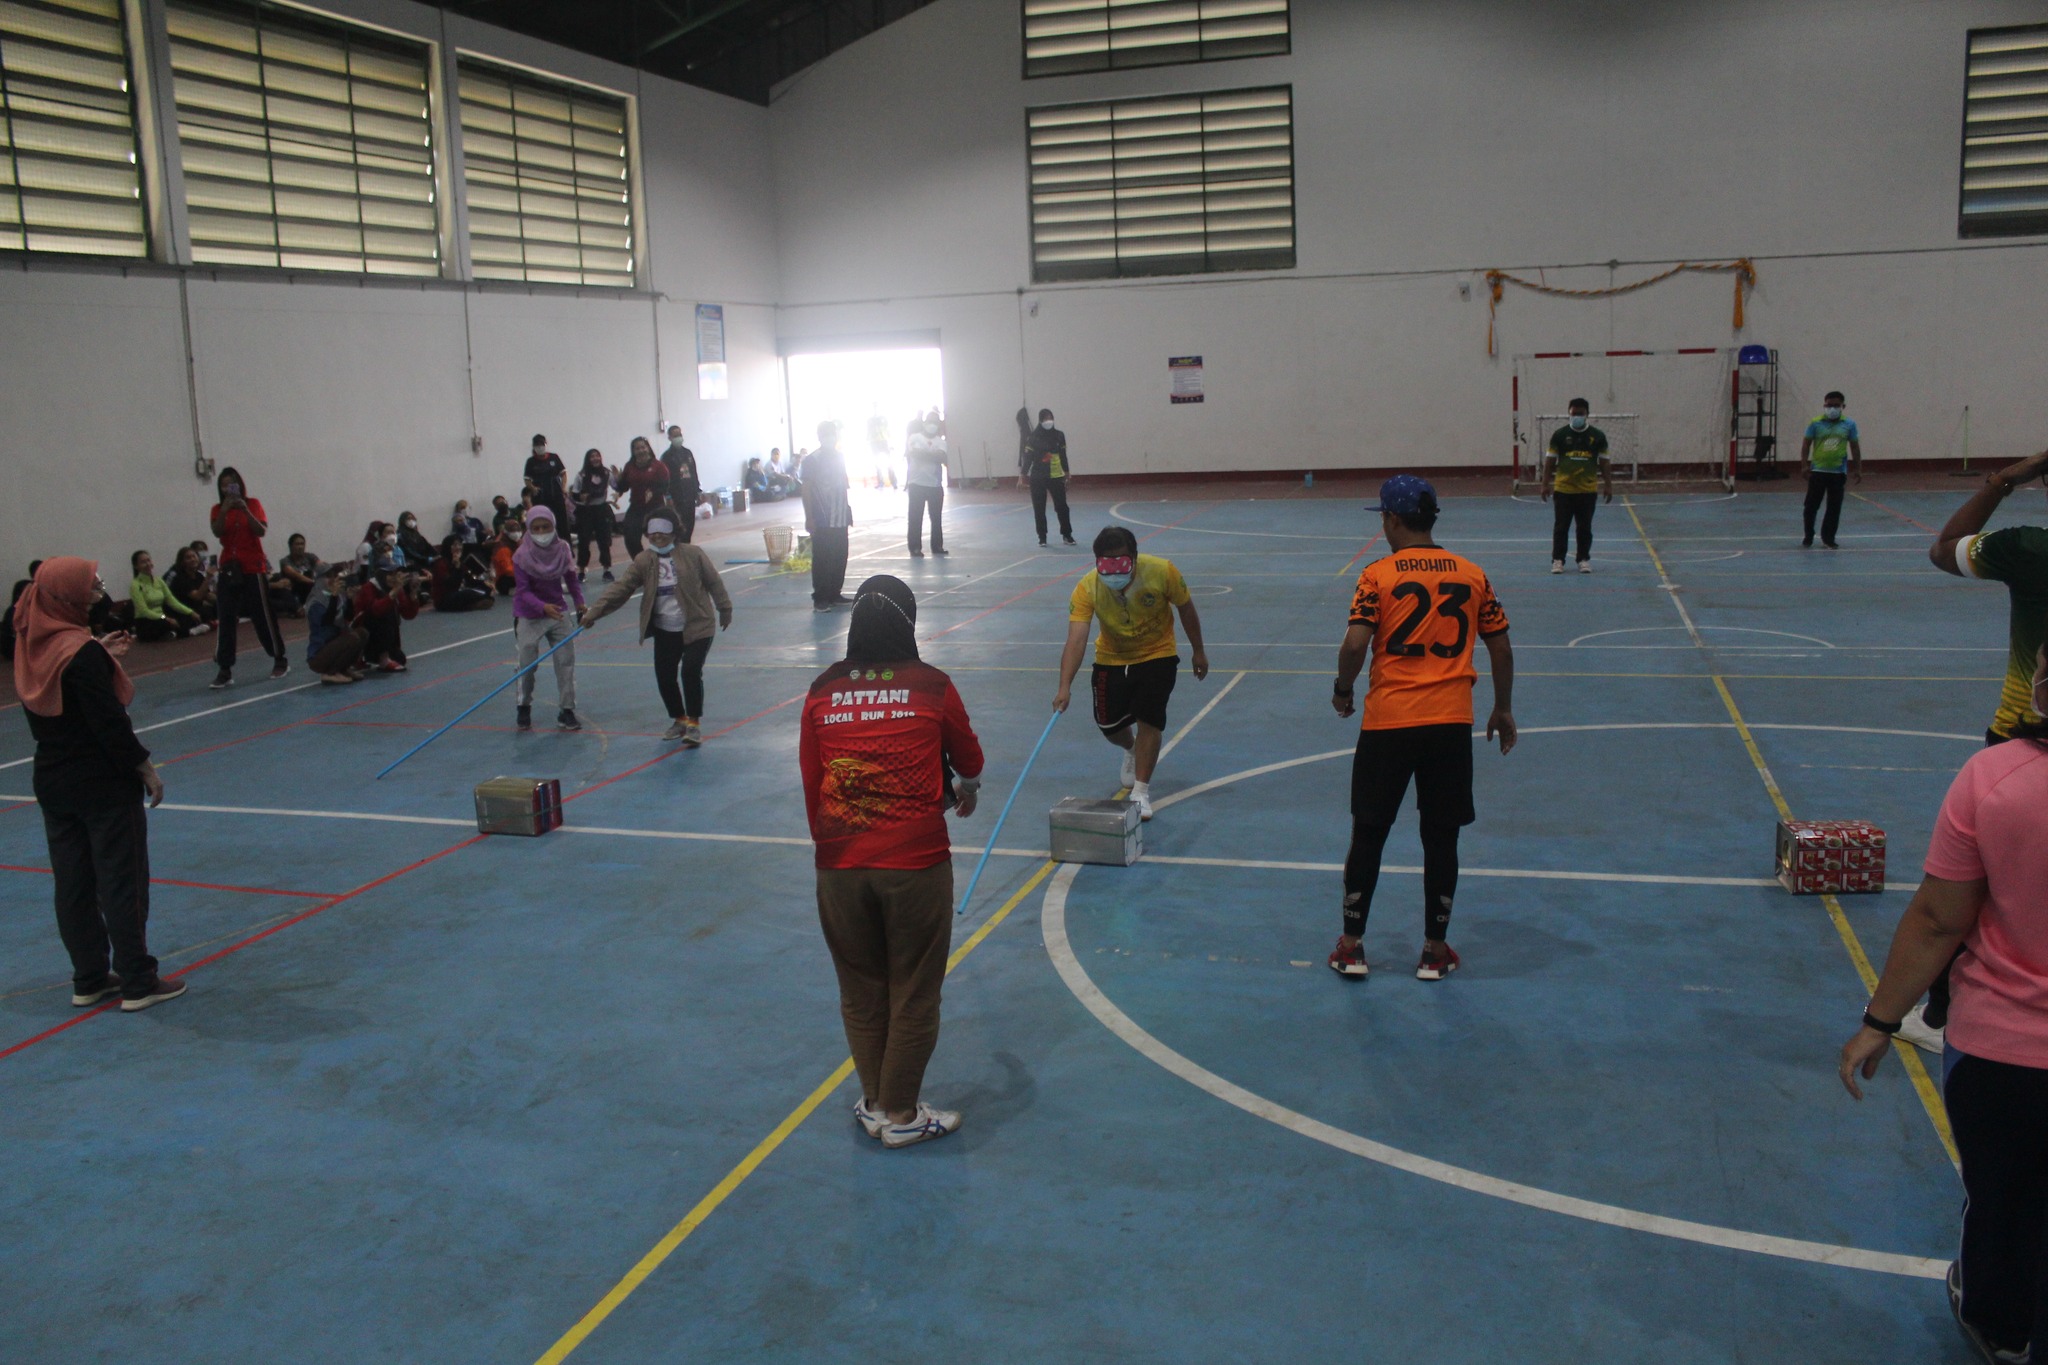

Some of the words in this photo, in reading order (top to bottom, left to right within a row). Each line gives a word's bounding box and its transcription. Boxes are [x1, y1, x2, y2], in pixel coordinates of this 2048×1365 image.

[1395, 559, 1457, 572] IBROHIM
[1386, 581, 1472, 658] 23
[831, 689, 910, 707] PATTANI
[823, 712, 854, 725] LOCAL
[861, 711, 885, 721] RUN
